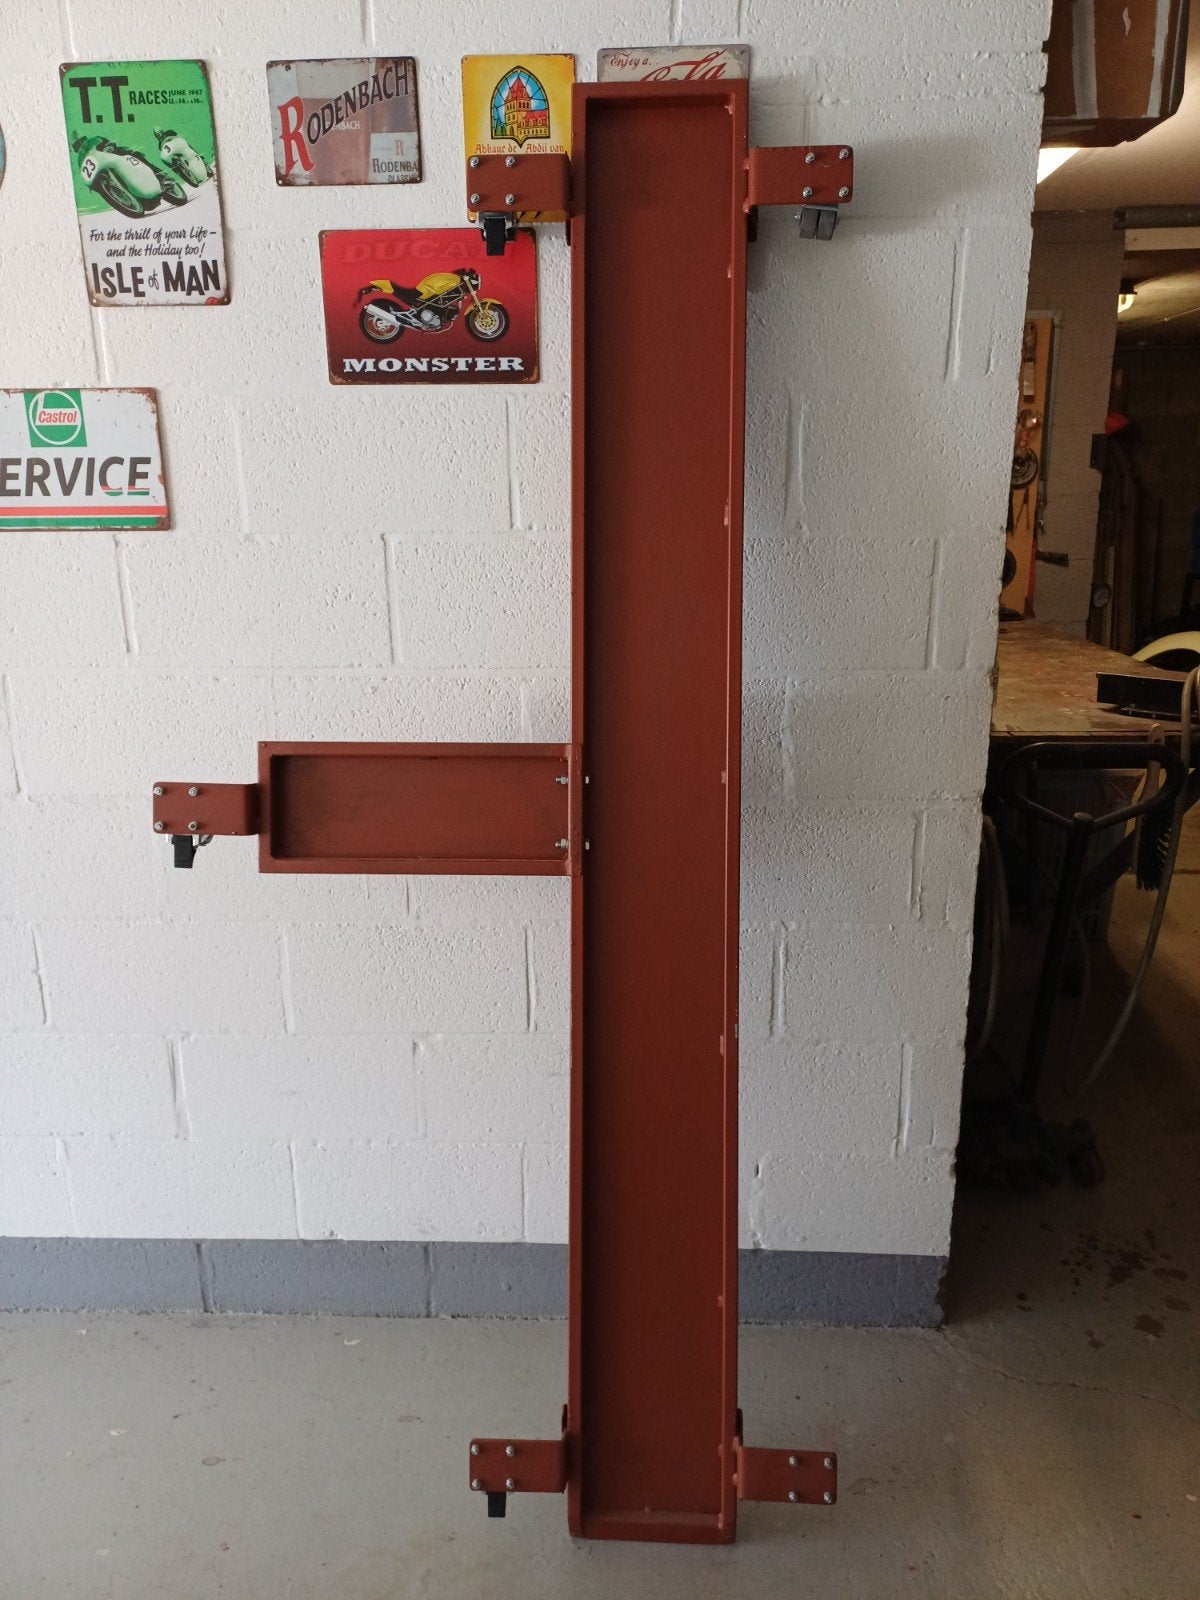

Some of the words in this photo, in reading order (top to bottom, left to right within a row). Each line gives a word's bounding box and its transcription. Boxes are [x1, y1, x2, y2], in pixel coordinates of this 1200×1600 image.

[610, 53, 640, 71] Enjoy
[128, 90, 168, 105] RACES
[168, 89, 186, 97] JUNE
[277, 63, 409, 179] RODENBACH
[89, 229, 105, 242] For
[107, 228, 122, 240] the
[124, 228, 151, 240] thrill
[153, 227, 163, 243] of
[165, 227, 187, 244] your
[189, 226, 208, 243] Life
[106, 245, 125, 257] and
[128, 244, 143, 257] the
[144, 243, 182, 260] Holiday
[185, 243, 206, 258] too!
[91, 262, 146, 298] ISLE
[148, 268, 160, 290] of
[162, 259, 221, 296] MAN
[342, 357, 525, 373] MONSTER
[38, 410, 78, 424] Castrol
